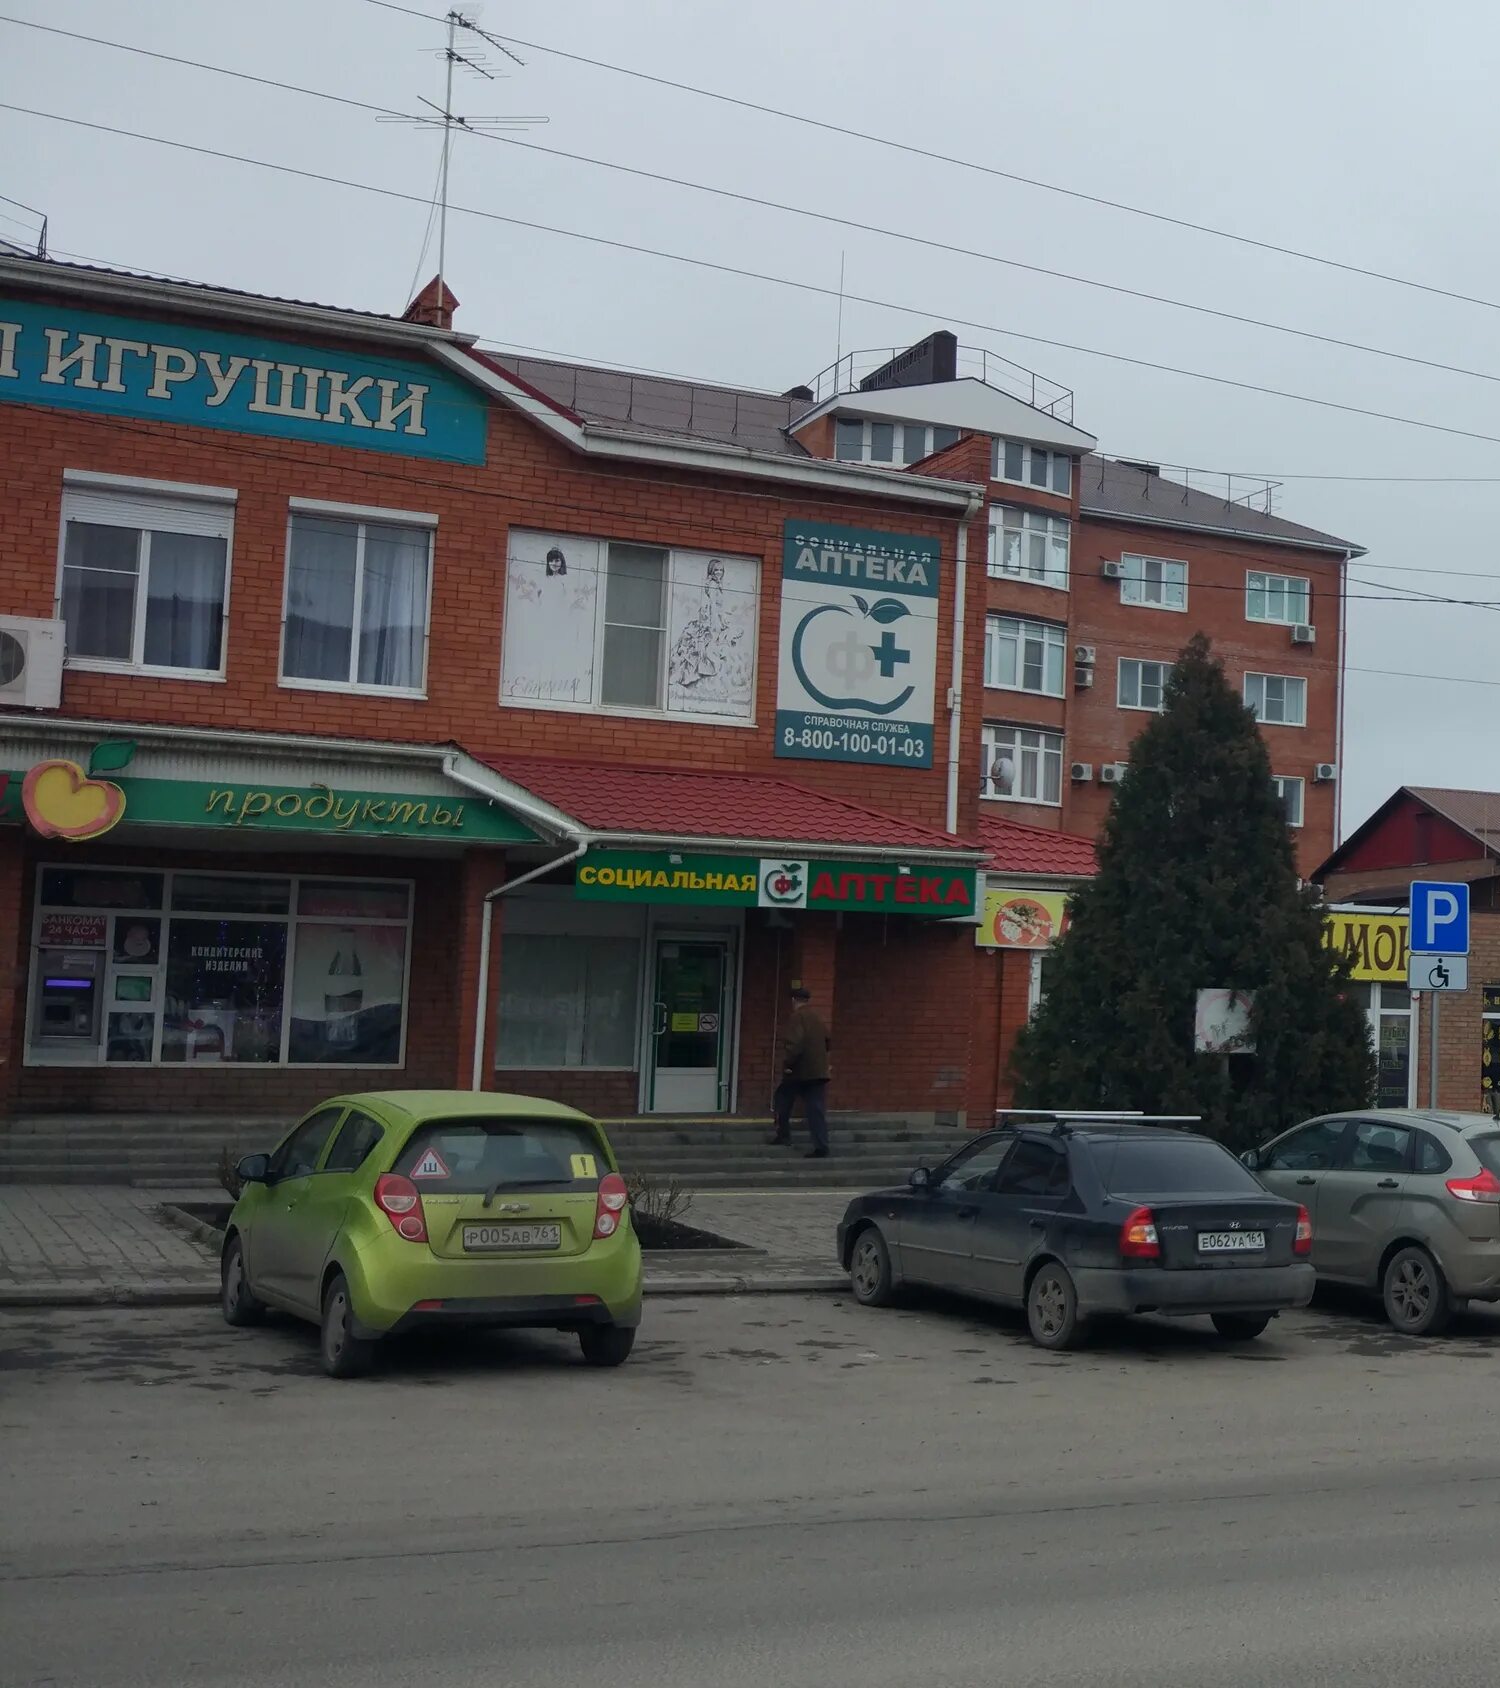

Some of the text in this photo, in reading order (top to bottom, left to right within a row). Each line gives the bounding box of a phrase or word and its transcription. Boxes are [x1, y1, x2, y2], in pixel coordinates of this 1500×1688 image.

[40, 328, 431, 436] ИГРУШКИ
[794, 534, 931, 563] СОЦИАЛЬНАЯ
[795, 547, 929, 586] АПТЕКА
[804, 714, 910, 735] СПРАВОЧНАЯ СЛУЖБА
[783, 727, 925, 758] 8-800-100-01-03
[206, 782, 464, 828] продукты
[579, 866, 757, 892] СОЦИАЛЬНАЯ
[810, 871, 971, 906] АПТЕКА
[64, 925, 98, 936] ЧАСА
[1426, 889, 1459, 945] P
[191, 946, 263, 959] КОНДИТЕРСКИЕ
[205, 960, 248, 972] ИЗДЕЛИЯ
